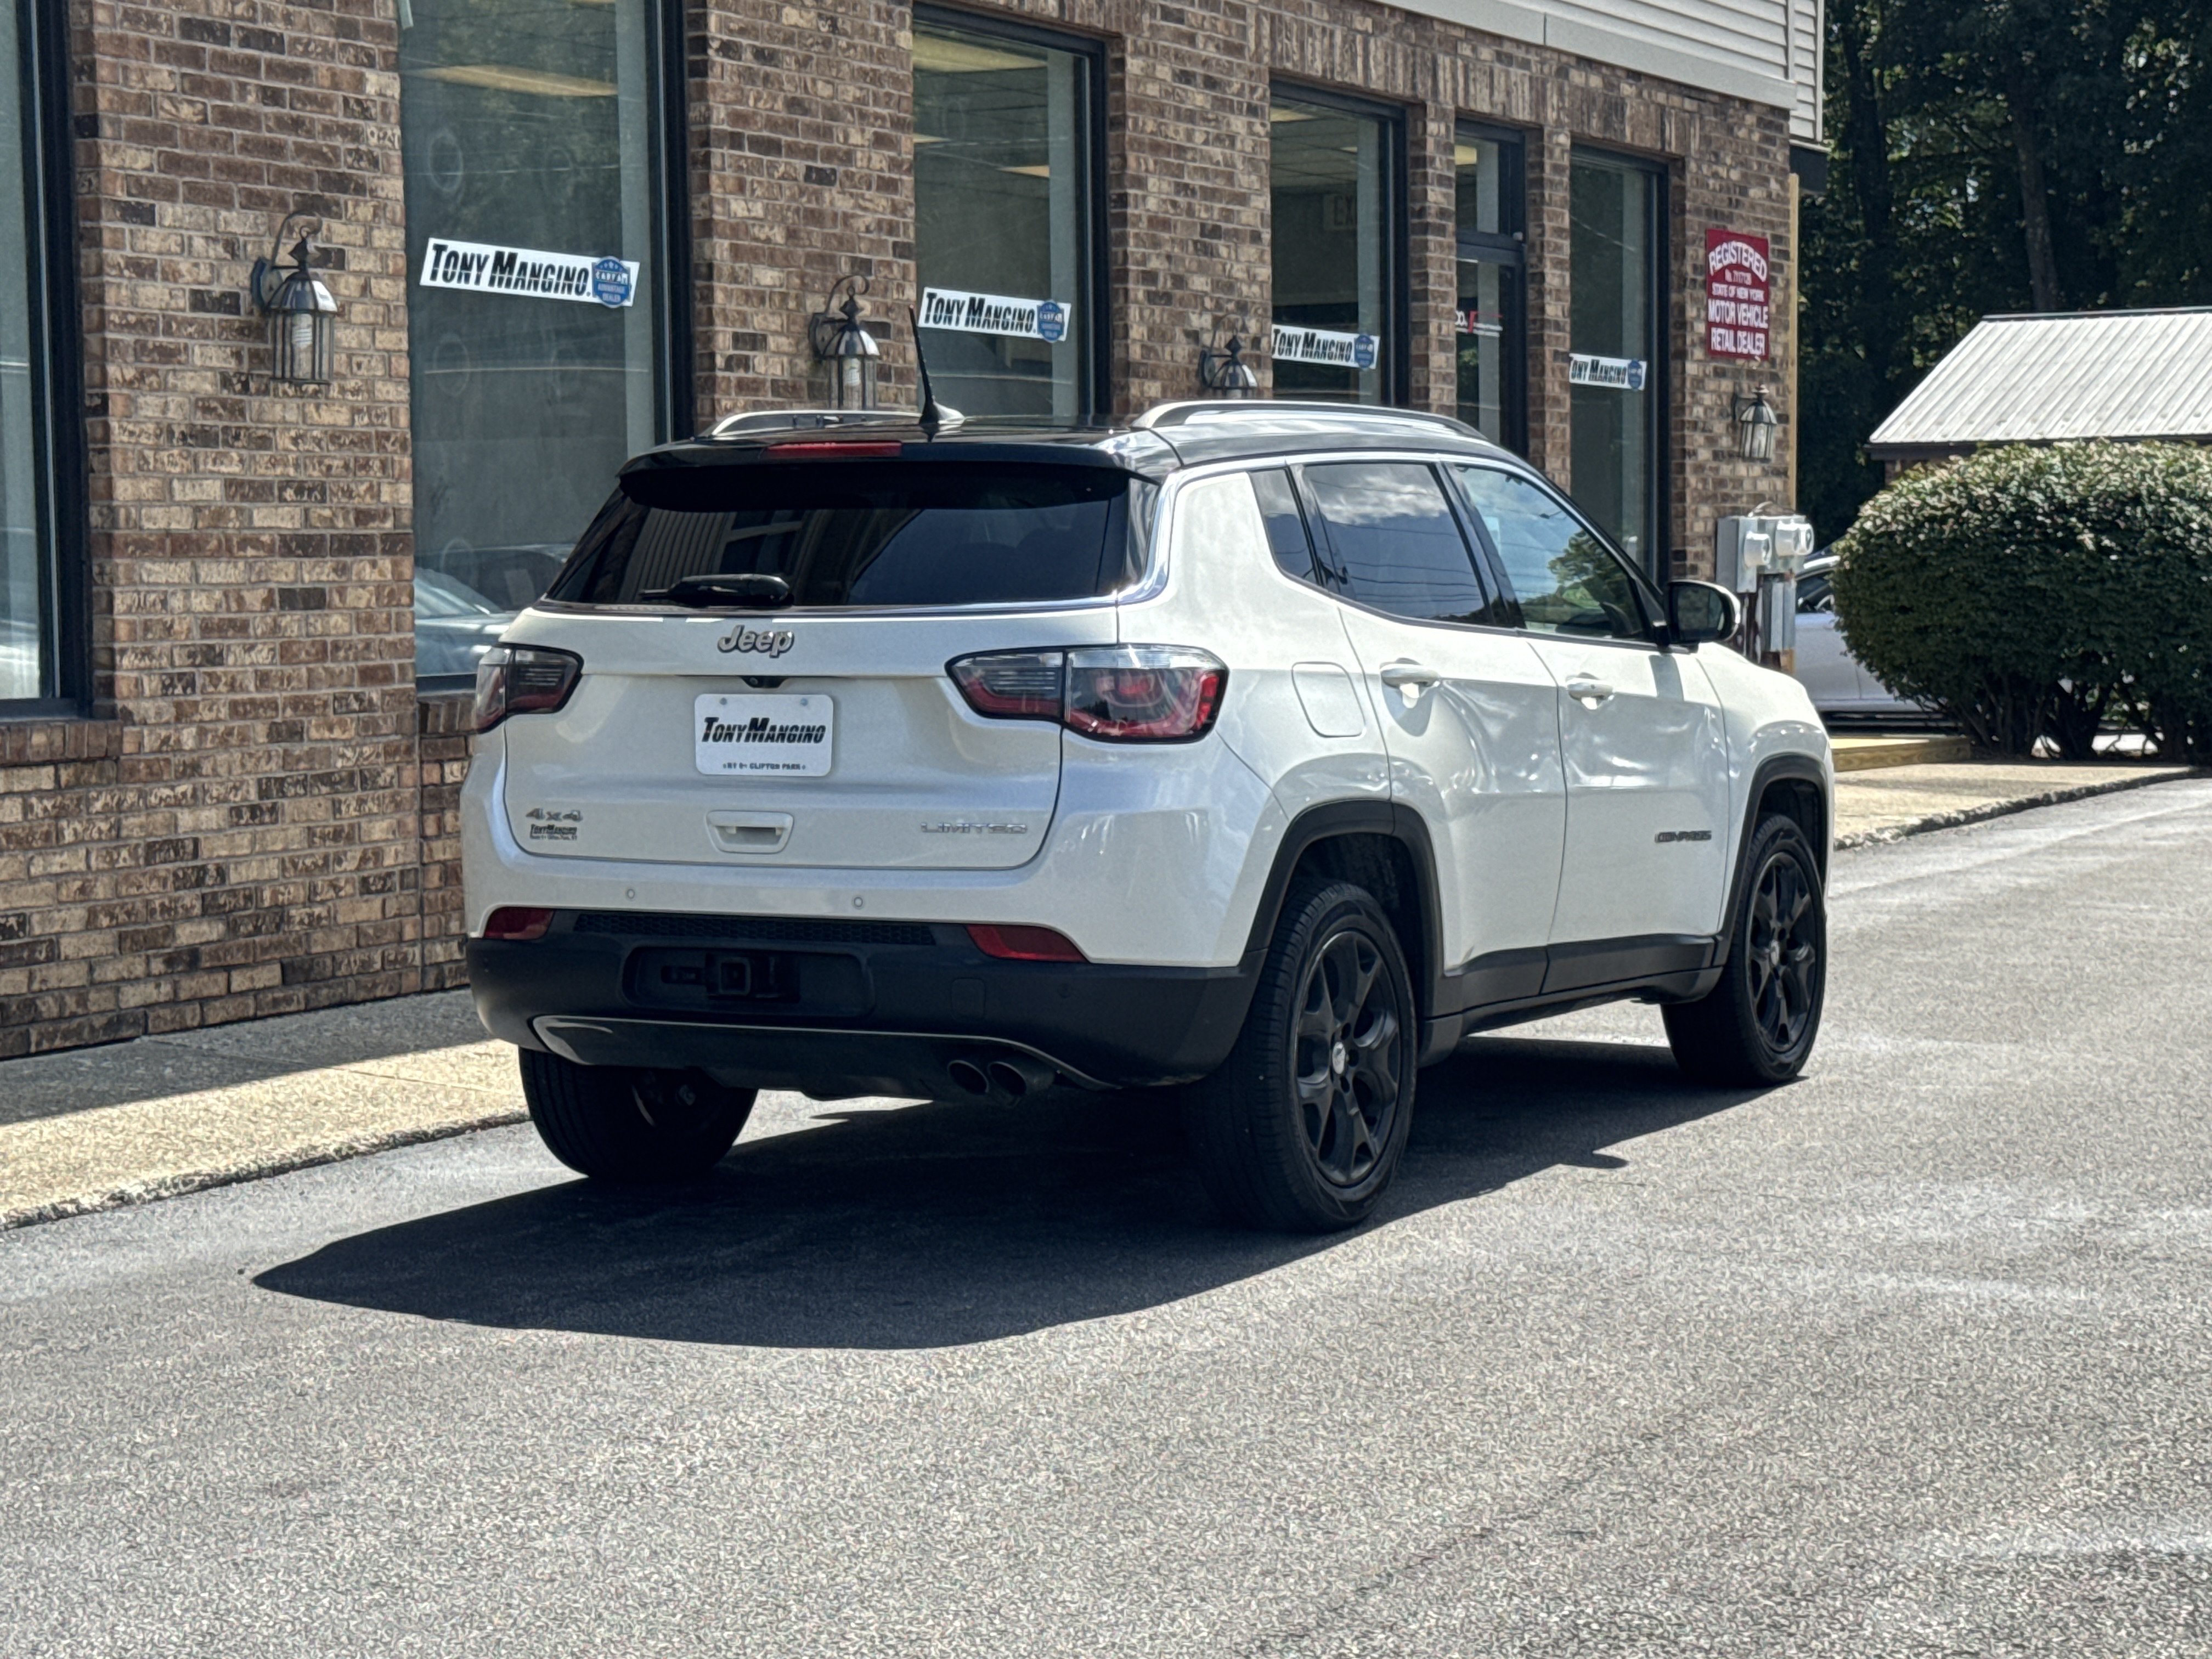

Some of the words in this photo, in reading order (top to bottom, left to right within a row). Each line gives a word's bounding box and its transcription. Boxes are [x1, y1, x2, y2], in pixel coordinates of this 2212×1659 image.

[430, 243, 490, 286] TONY
[1708, 240, 1768, 283] REGISTERED
[1712, 282, 1728, 297] STATE
[1729, 285, 1736, 298] OF
[1736, 286, 1749, 301] NEW
[1750, 288, 1764, 302] YORK
[924, 292, 966, 326] TONY
[1708, 298, 1736, 325] MOTOR
[1737, 303, 1768, 329] VEHICLE
[1272, 329, 1302, 357] TONY
[1711, 327, 1736, 353] RETAIL
[1737, 330, 1765, 356] DEALER
[1571, 360, 1589, 381] ONY
[718, 625, 794, 658] Jeep
[526, 808, 583, 822] 4x4
